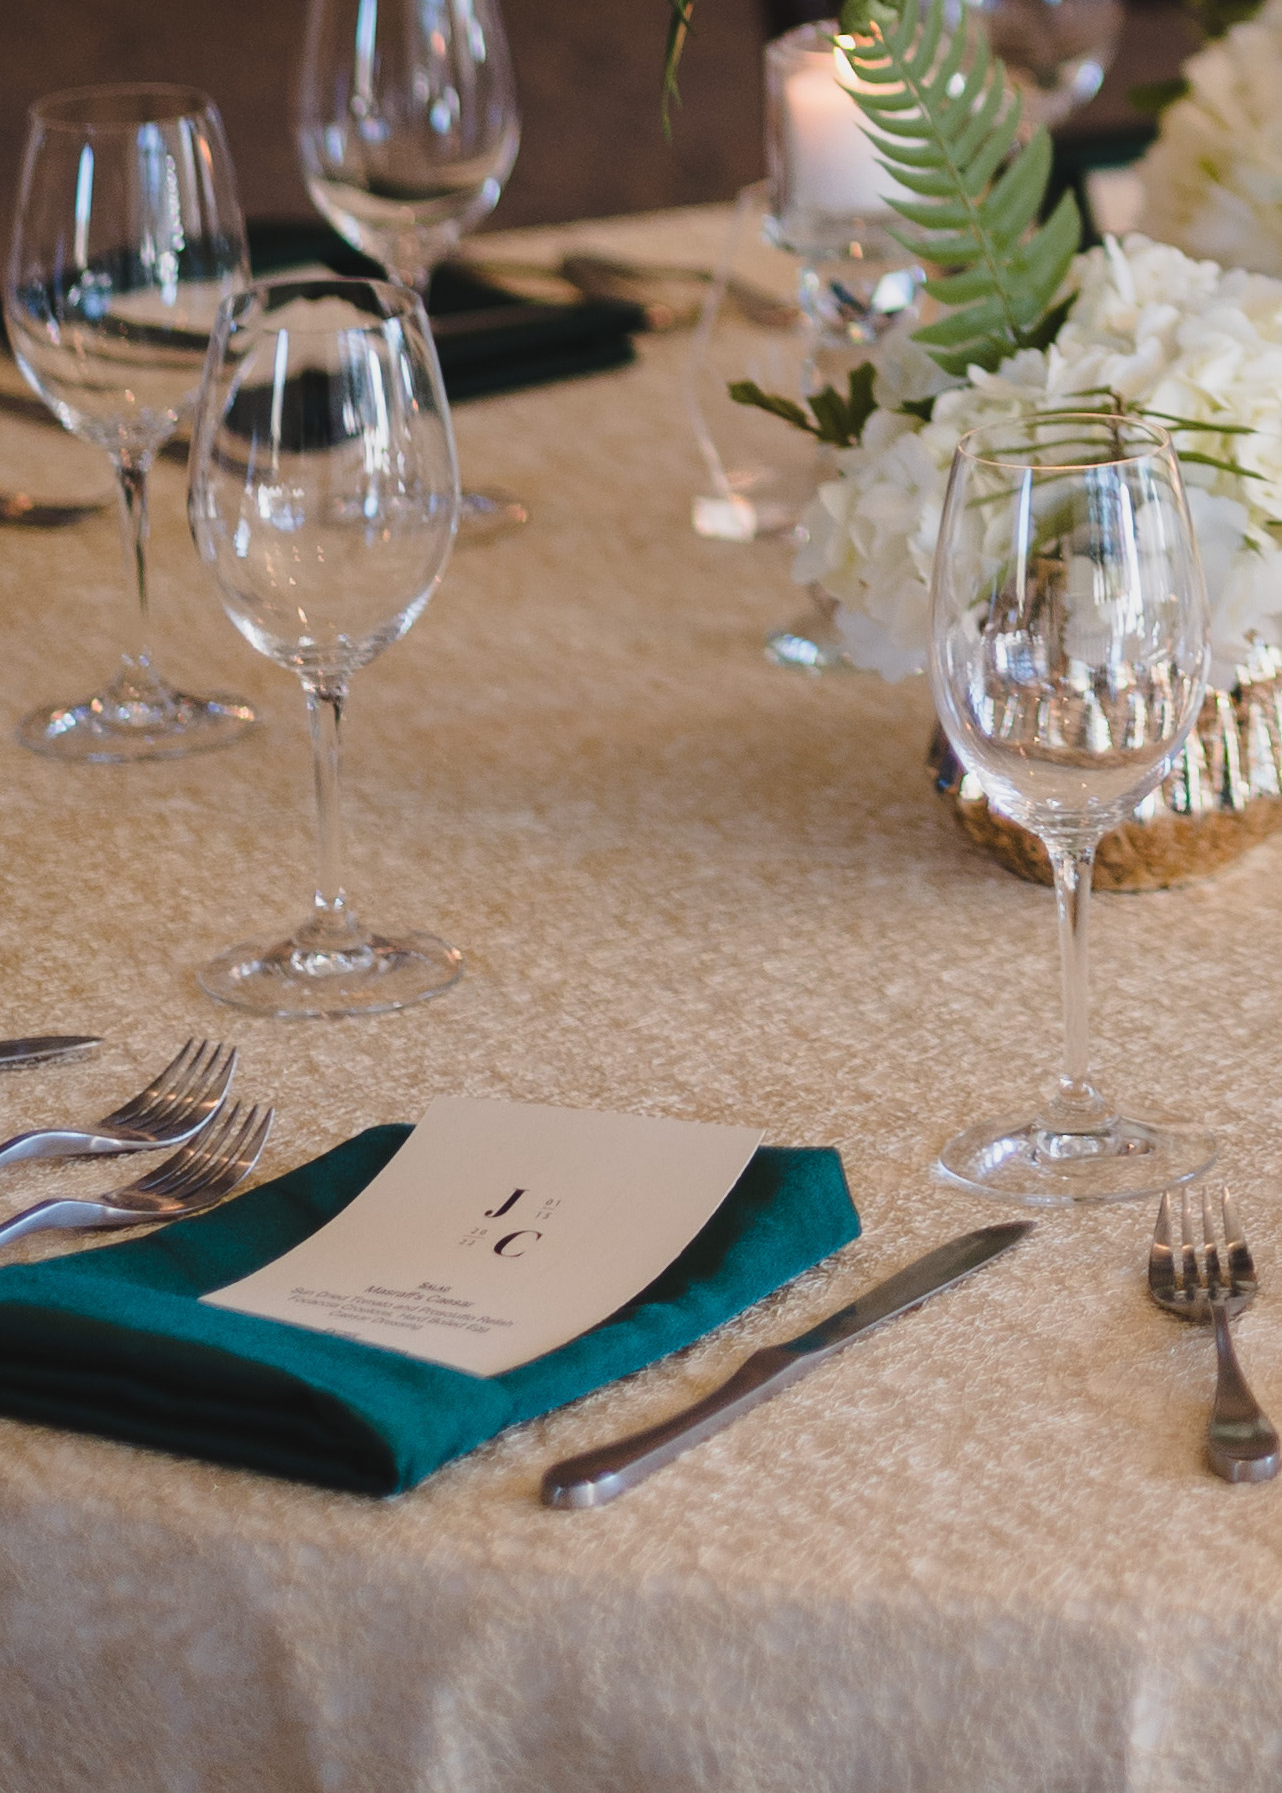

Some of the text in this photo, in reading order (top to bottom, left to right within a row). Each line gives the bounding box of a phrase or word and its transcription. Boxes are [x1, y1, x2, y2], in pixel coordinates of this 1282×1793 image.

[485, 1188, 530, 1218] J
[545, 1199, 561, 1207] 01
[493, 1230, 542, 1258] C
[426, 1295, 475, 1307] Caesar
